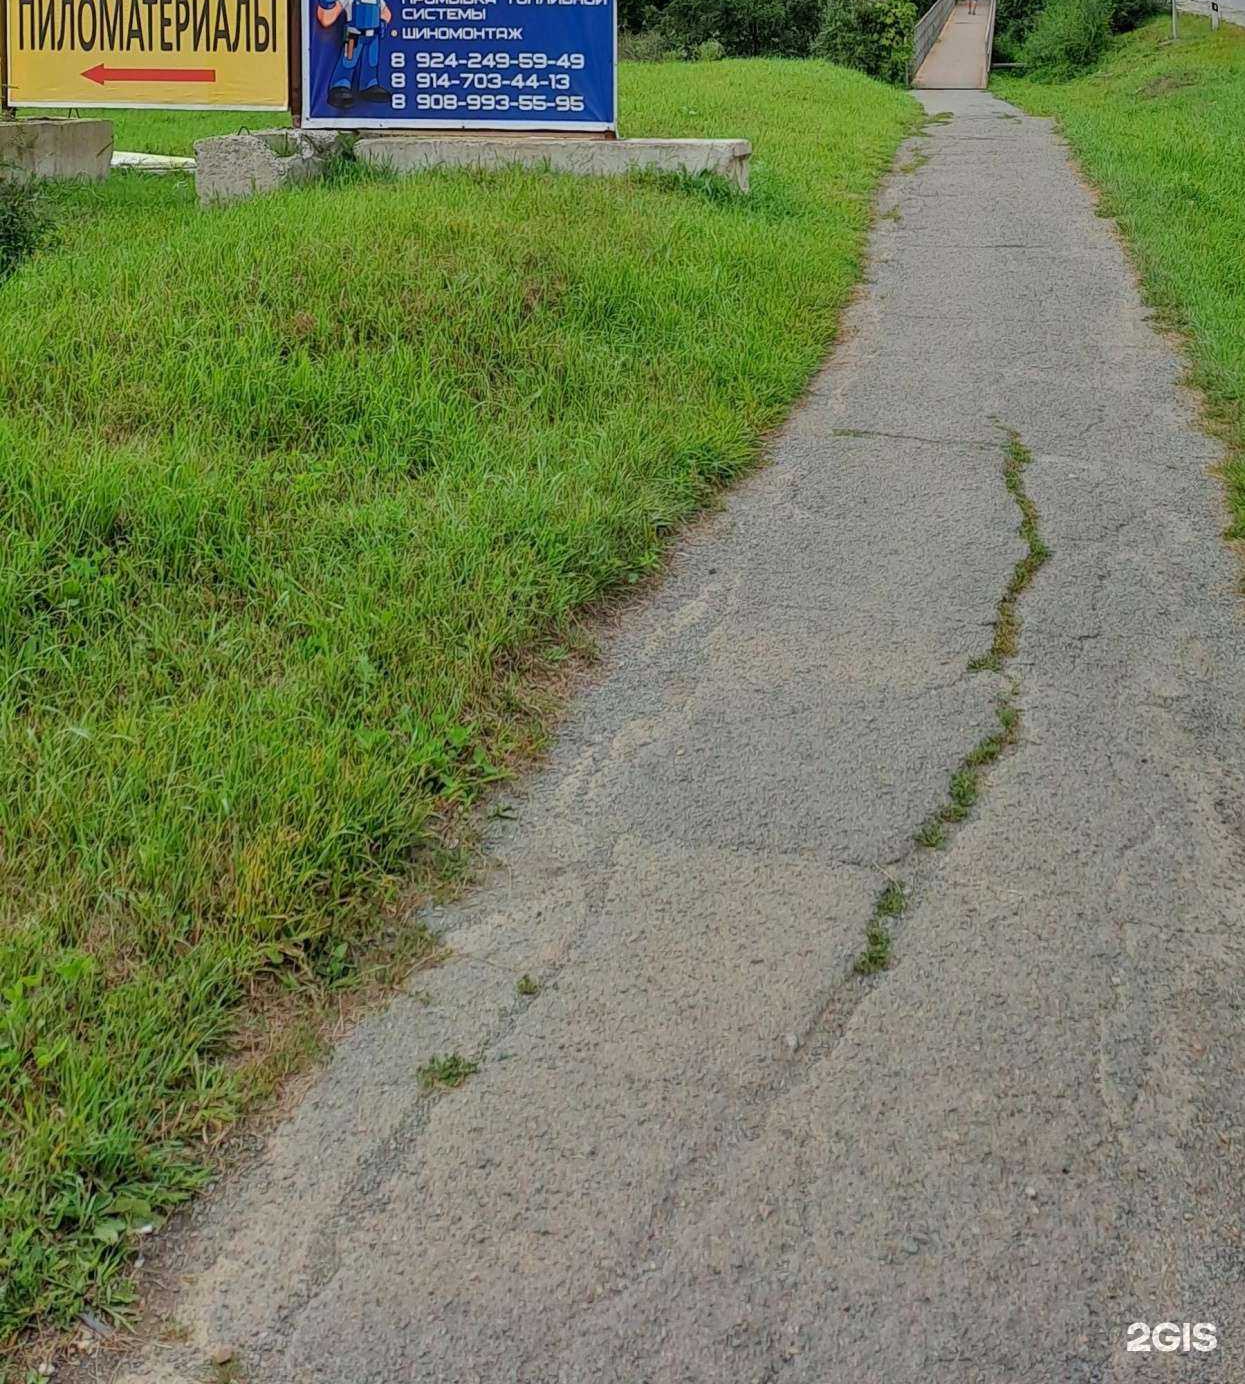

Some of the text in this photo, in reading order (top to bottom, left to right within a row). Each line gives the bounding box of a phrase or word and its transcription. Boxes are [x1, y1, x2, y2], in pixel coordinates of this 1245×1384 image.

[402, 8, 486, 21] СИСТЕМЫ
[402, 27, 523, 41] ШИНОМОНТАЖ
[391, 53, 585, 69] 8 924-249-59-49
[391, 73, 570, 90] 8 914-703-44-13
[391, 94, 585, 111] 8 908-993-55-95
